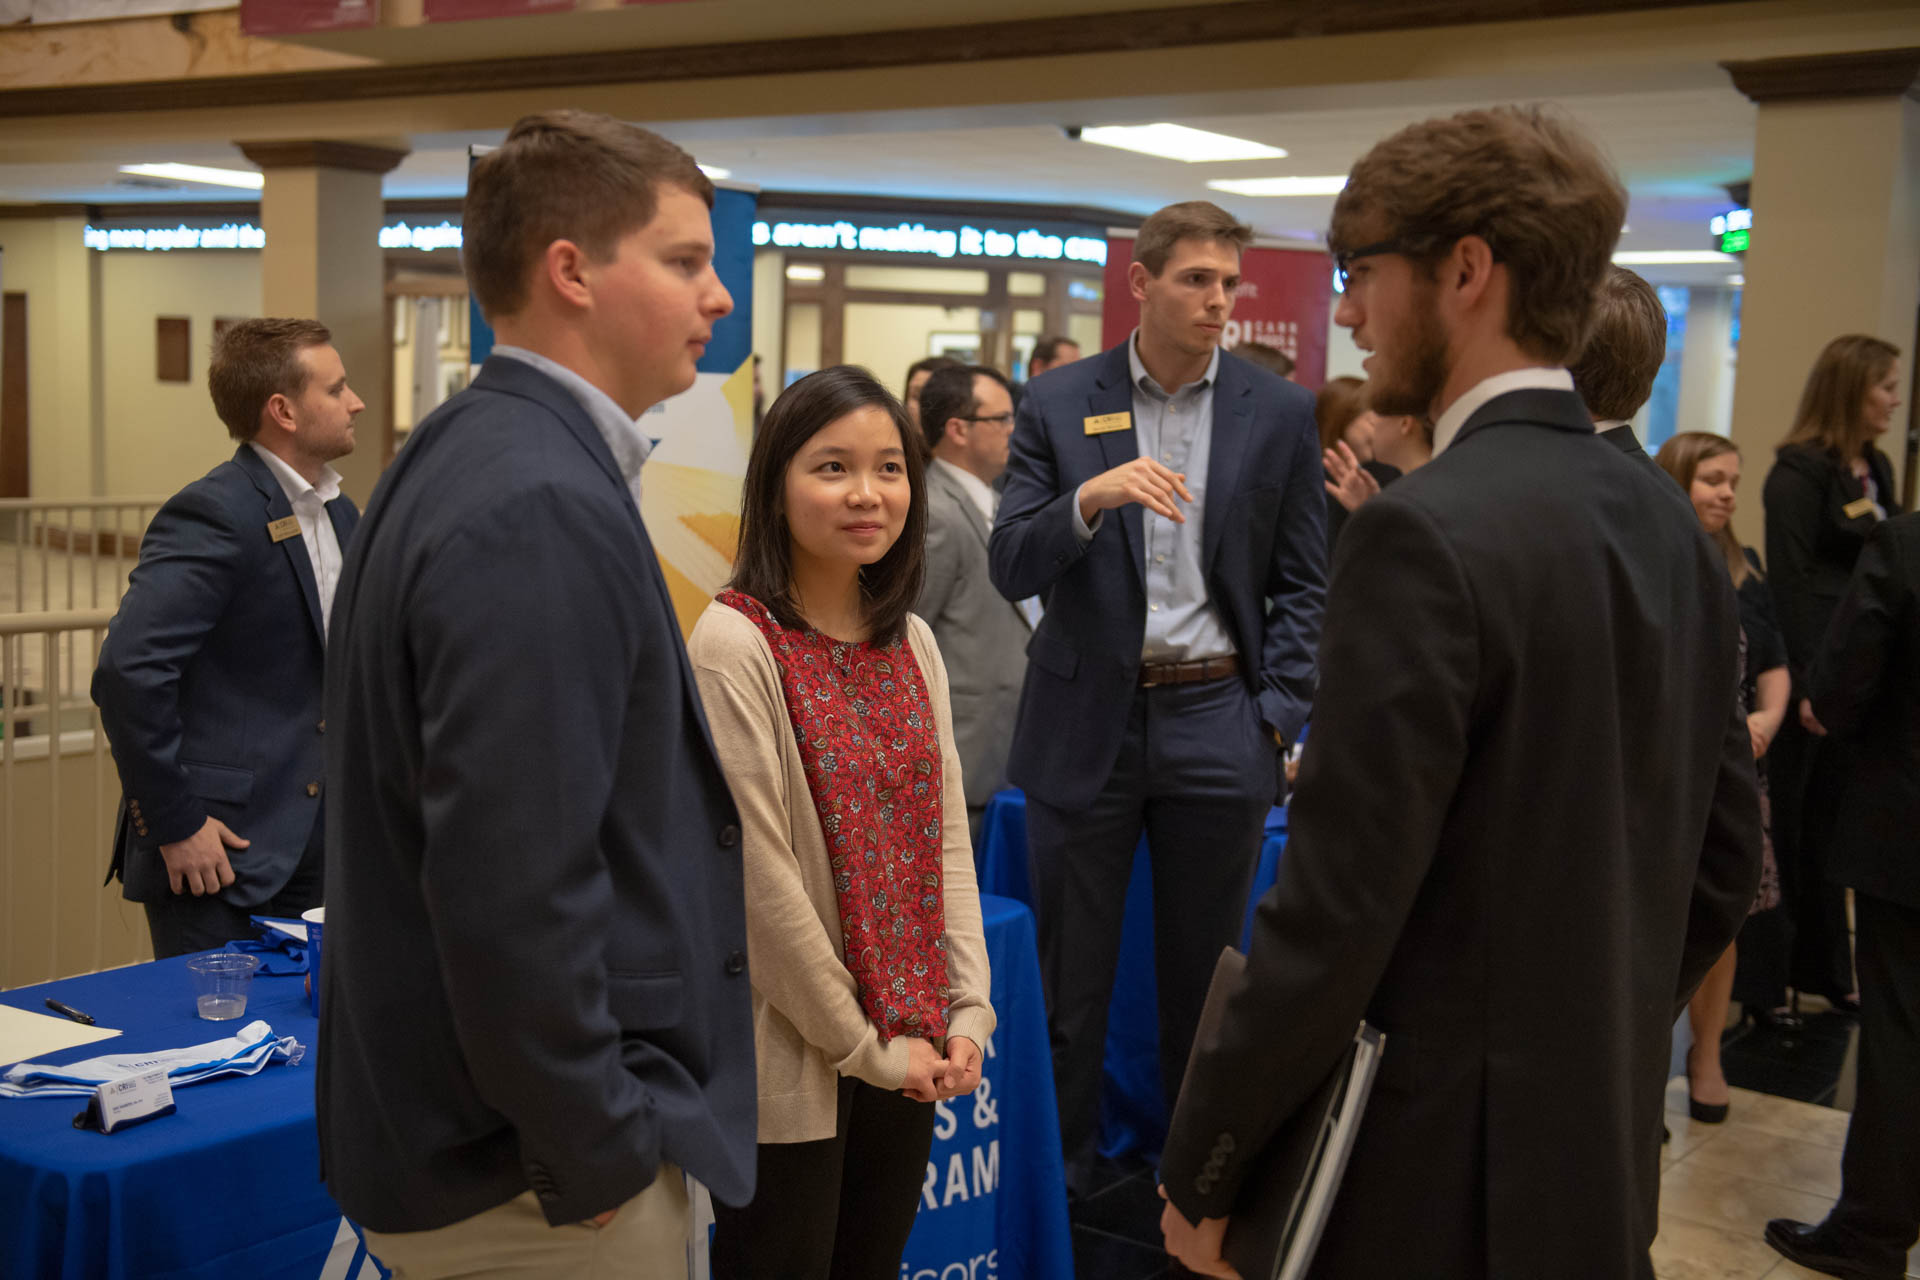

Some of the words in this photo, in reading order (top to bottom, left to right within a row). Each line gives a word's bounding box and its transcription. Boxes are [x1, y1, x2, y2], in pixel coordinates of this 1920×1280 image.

[109, 228, 146, 249] more
[772, 220, 858, 250] aren't
[859, 222, 957, 258] making
[959, 225, 984, 256] it
[983, 228, 1015, 257] to
[1016, 228, 1063, 260] the
[973, 1076, 1000, 1129] &
